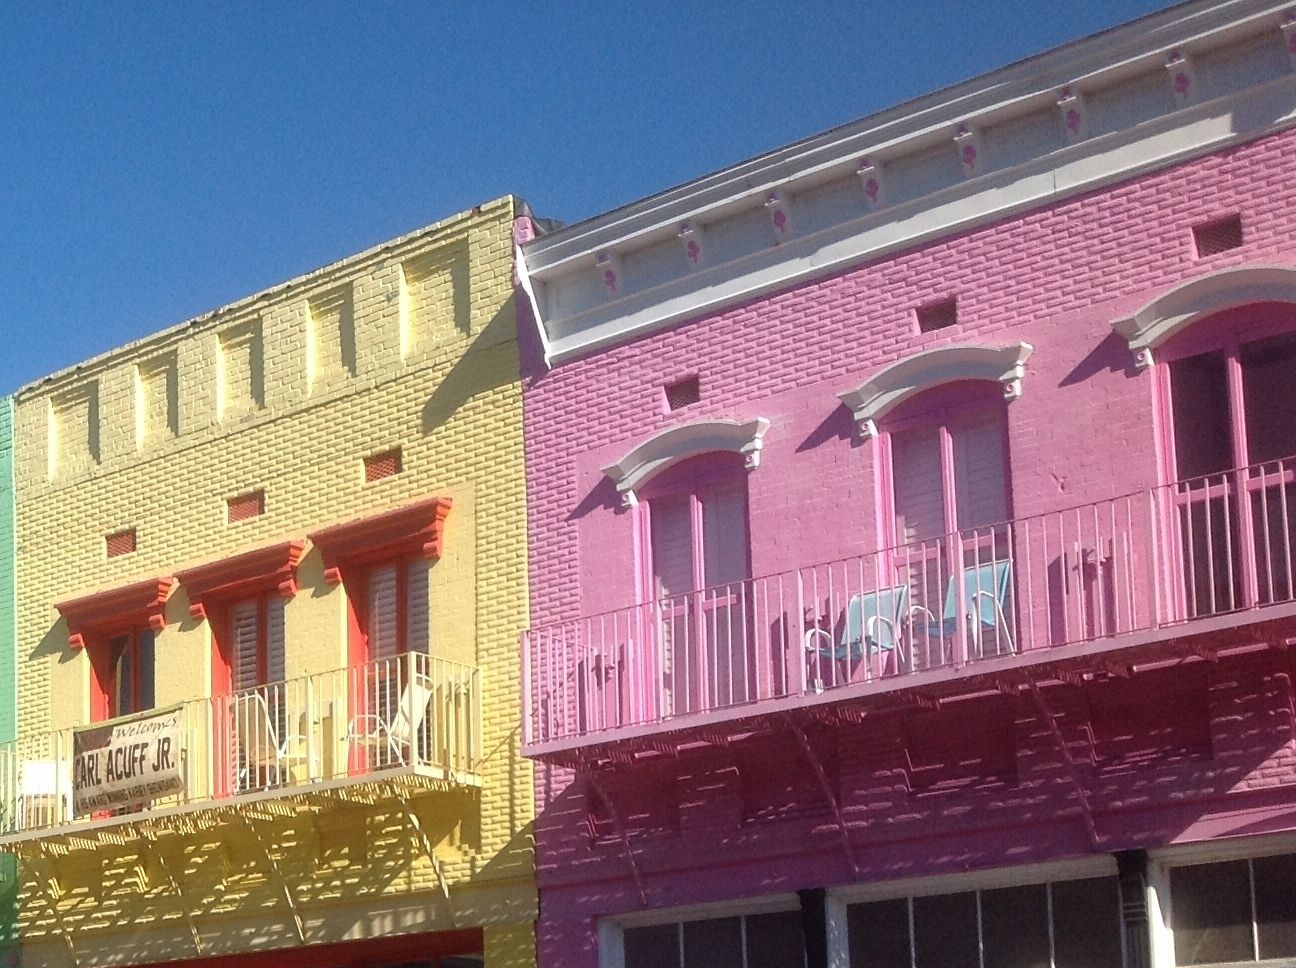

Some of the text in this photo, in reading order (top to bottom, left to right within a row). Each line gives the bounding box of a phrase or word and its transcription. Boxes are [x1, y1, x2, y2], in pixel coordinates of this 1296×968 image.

[75, 752, 102, 791] CARL
[106, 742, 149, 783] ACUFF
[151, 736, 175, 772] JR.
